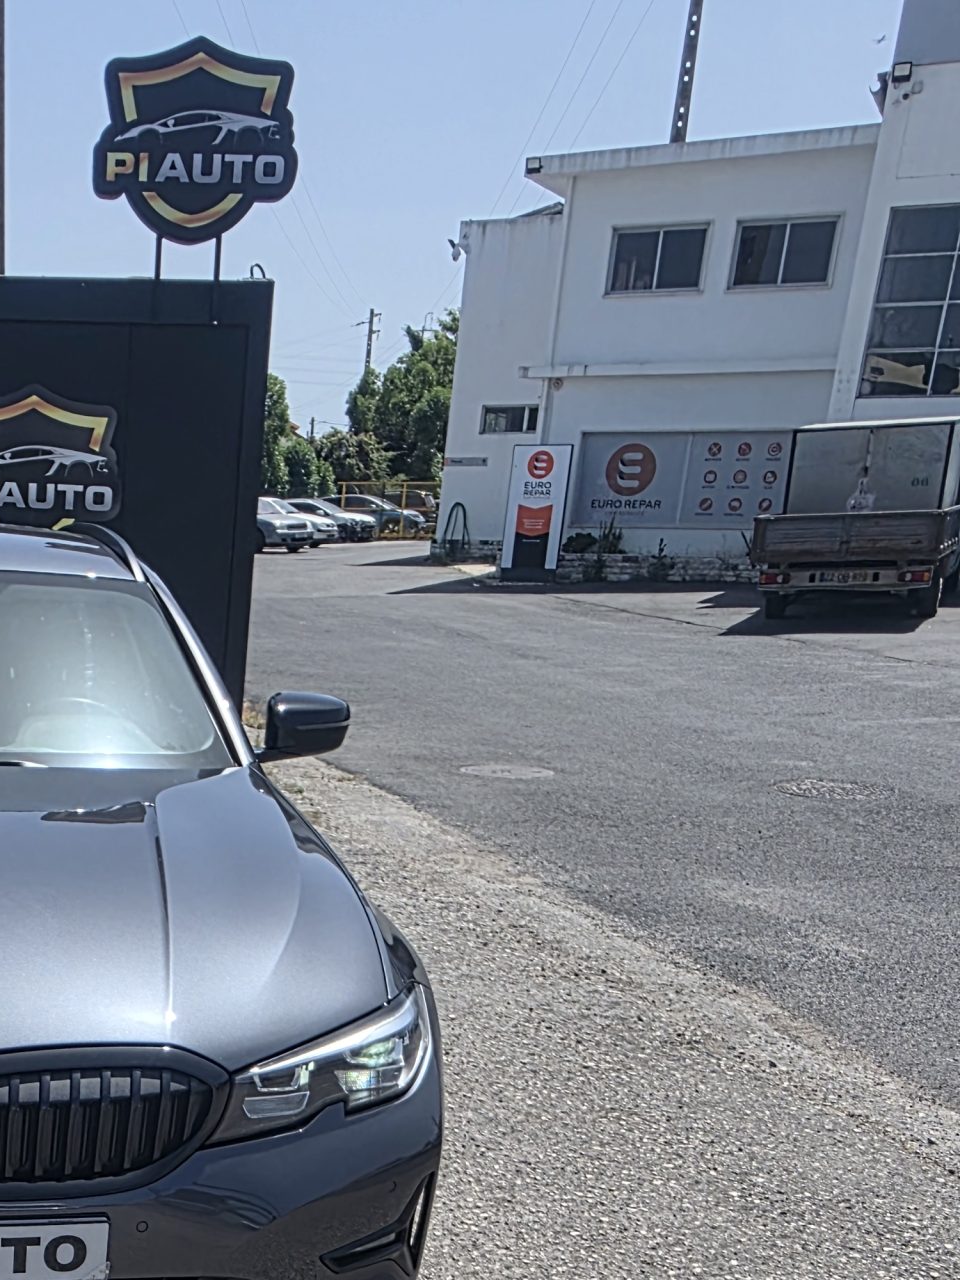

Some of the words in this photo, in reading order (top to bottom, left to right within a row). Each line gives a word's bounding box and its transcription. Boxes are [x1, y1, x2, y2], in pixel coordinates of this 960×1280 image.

[154, 152, 285, 185] AUTO
[524, 481, 552, 489] EURO
[523, 488, 551, 497] REPAR
[591, 499, 622, 509] EURO
[624, 499, 662, 510] REPAR
